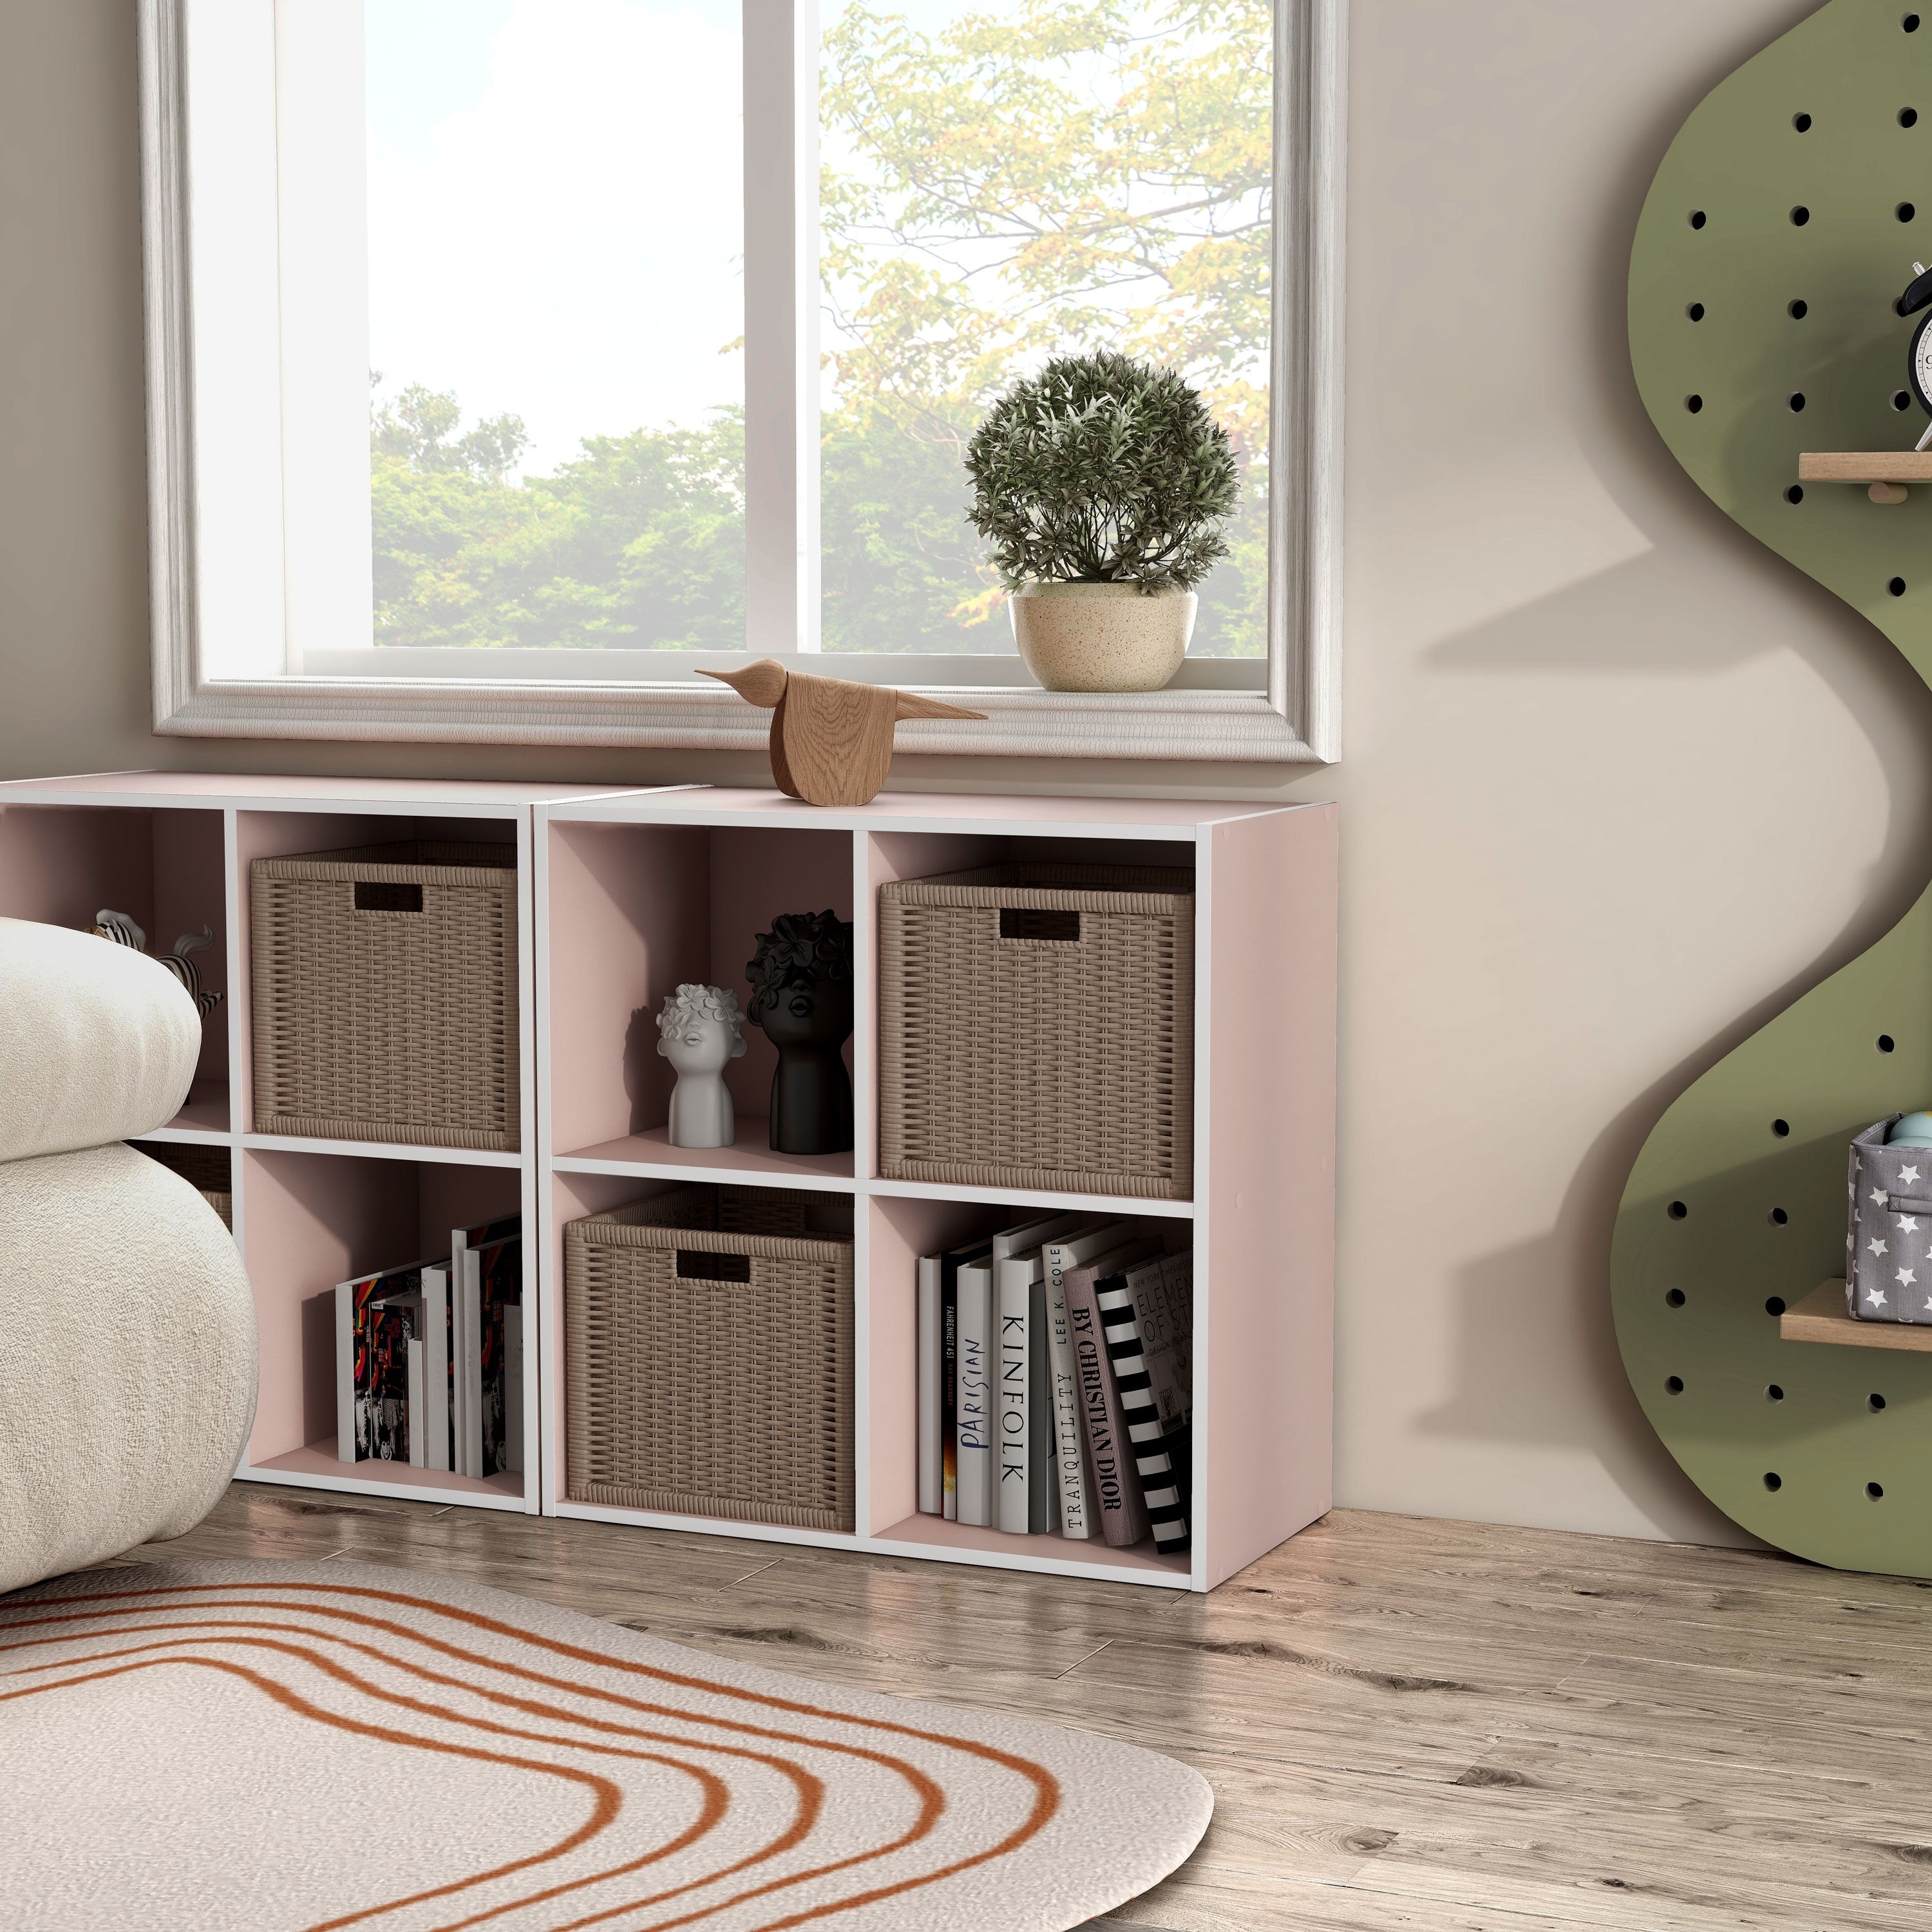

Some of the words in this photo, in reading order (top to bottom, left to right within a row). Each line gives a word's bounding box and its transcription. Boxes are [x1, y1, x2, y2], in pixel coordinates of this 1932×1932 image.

[1050, 1249, 1063, 1286] COLE
[1133, 1278, 1145, 1289] NEW
[1146, 1271, 1160, 1283] YORK
[1054, 1296, 1064, 1309] K.
[1072, 1307, 1094, 1335] BY
[946, 1305, 954, 1346] FAHRENHEIT
[1056, 1319, 1066, 1344] LEE
[1144, 1314, 1164, 1342] OF
[946, 1347, 954, 1359] 451
[957, 1339, 989, 1449] PARISIAN
[1002, 1314, 1024, 1482] KINFOLK
[1077, 1340, 1113, 1452] CHRISTIAN
[1057, 1373, 1082, 1528] TRANQUILITY
[1097, 1457, 1122, 1511] DIOR
